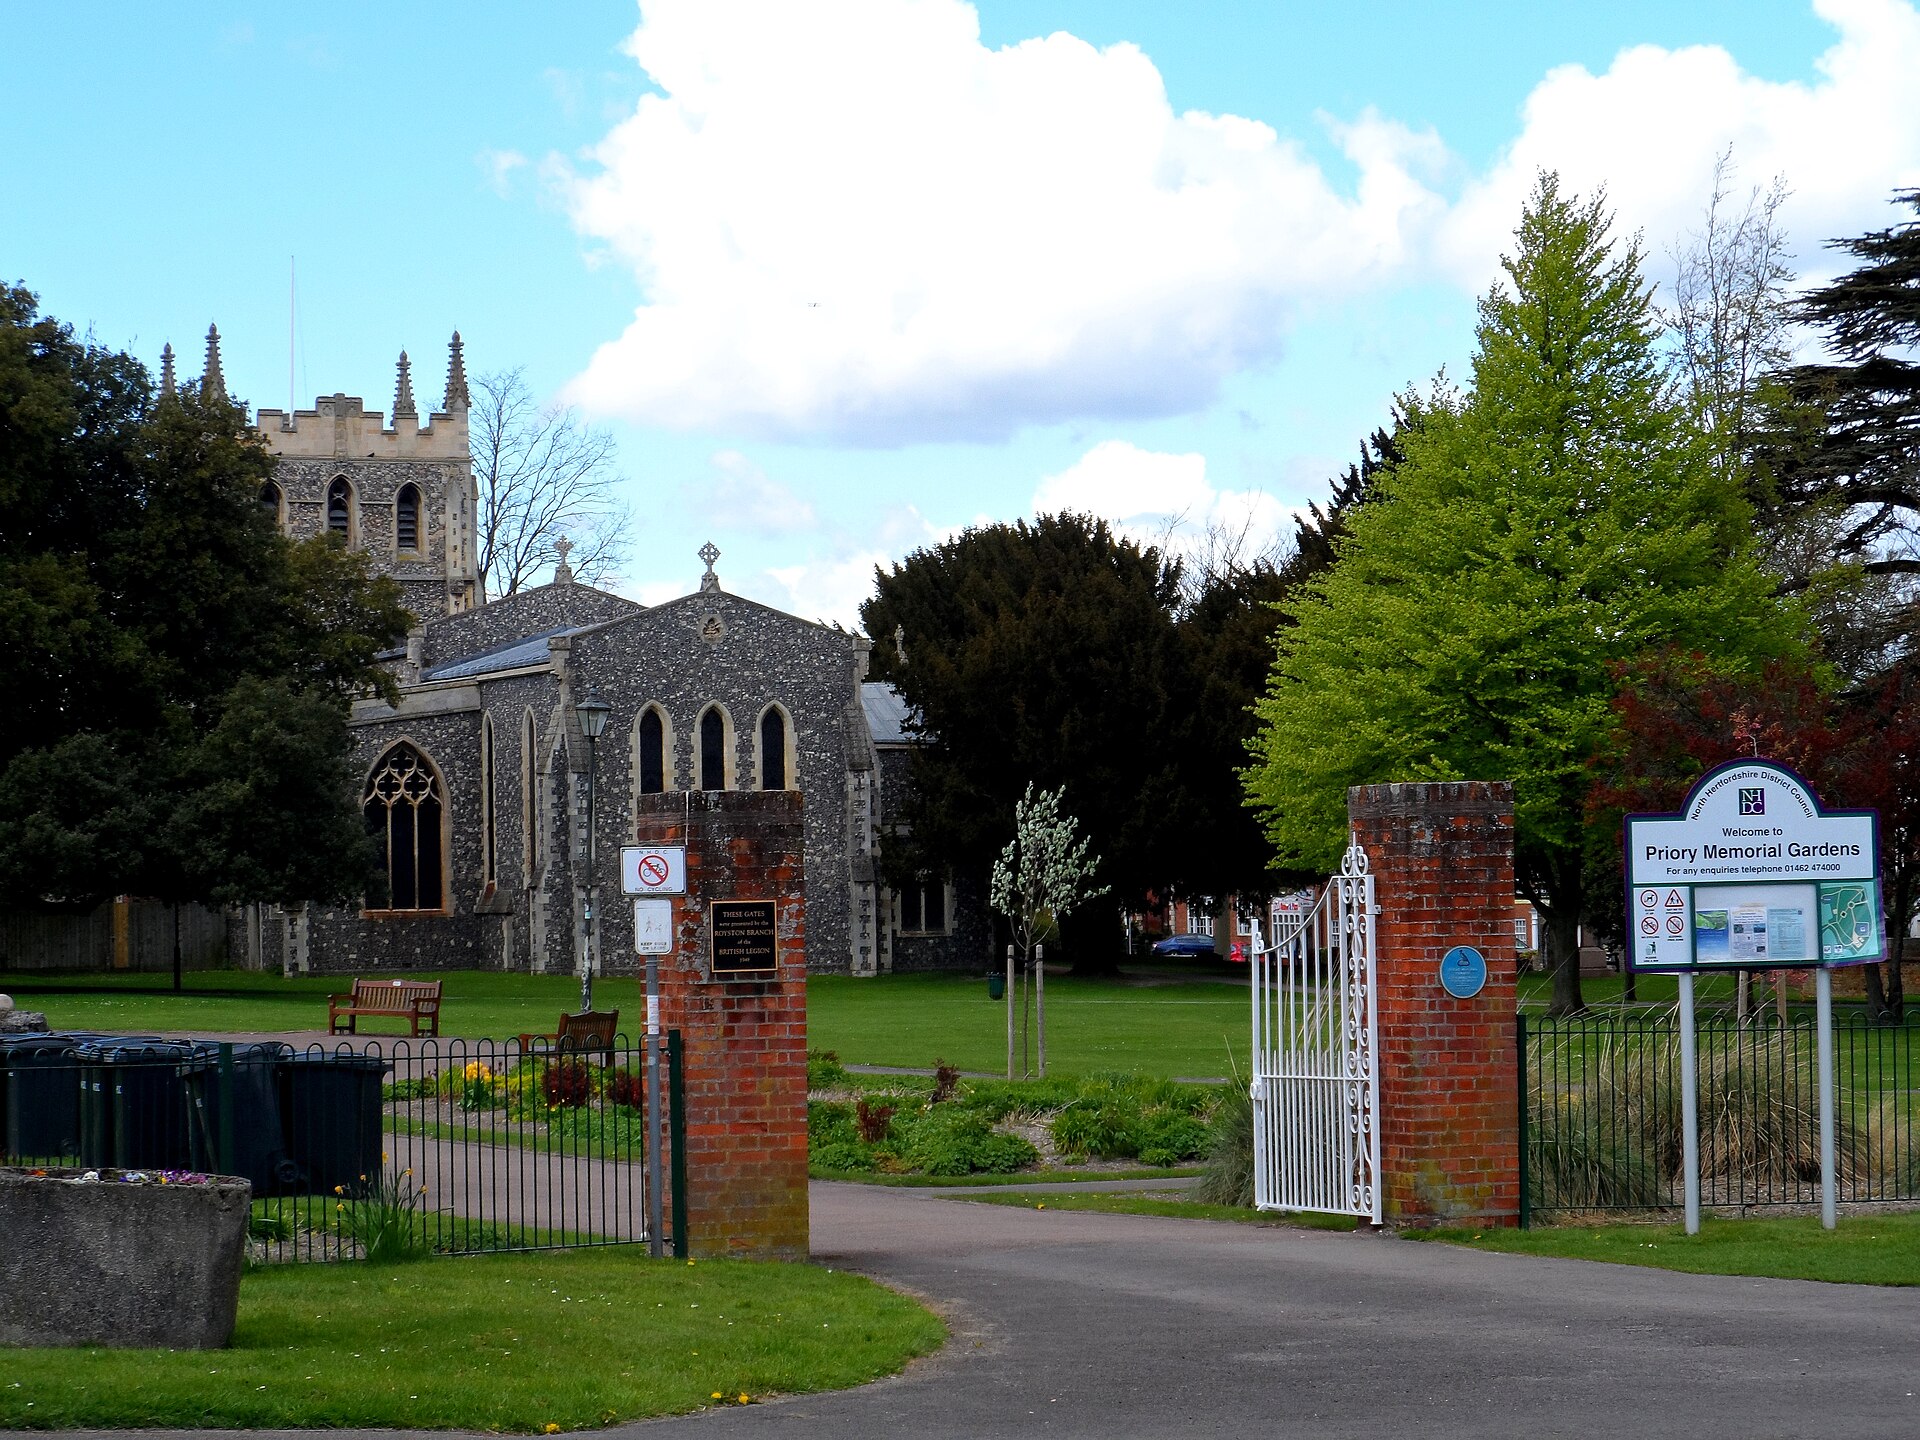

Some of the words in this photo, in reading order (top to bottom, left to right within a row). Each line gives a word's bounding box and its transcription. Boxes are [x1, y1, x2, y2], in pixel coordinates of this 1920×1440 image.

[1691, 797, 1707, 820] North
[1705, 771, 1759, 797] Hertfordshire
[1761, 771, 1790, 790] District
[1790, 788, 1814, 819] Council
[1722, 827, 1770, 837] Welcome
[1773, 827, 1783, 836] to
[1646, 845, 1698, 864] Priory
[1703, 843, 1782, 860] Memorial
[1787, 841, 1861, 858] Gardens
[1666, 867, 1681, 875] For
[1682, 868, 1698, 876] any
[1700, 866, 1739, 876] enquiries
[1741, 865, 1783, 875] telephone
[1784, 864, 1810, 873] 01462
[1811, 863, 1841, 872] 474000
[744, 910, 765, 918] GATES
[714, 929, 745, 937] ROYSTON
[746, 928, 774, 936] BRANCH
[719, 948, 744, 956] BRITISH
[745, 947, 770, 955] LEGION
